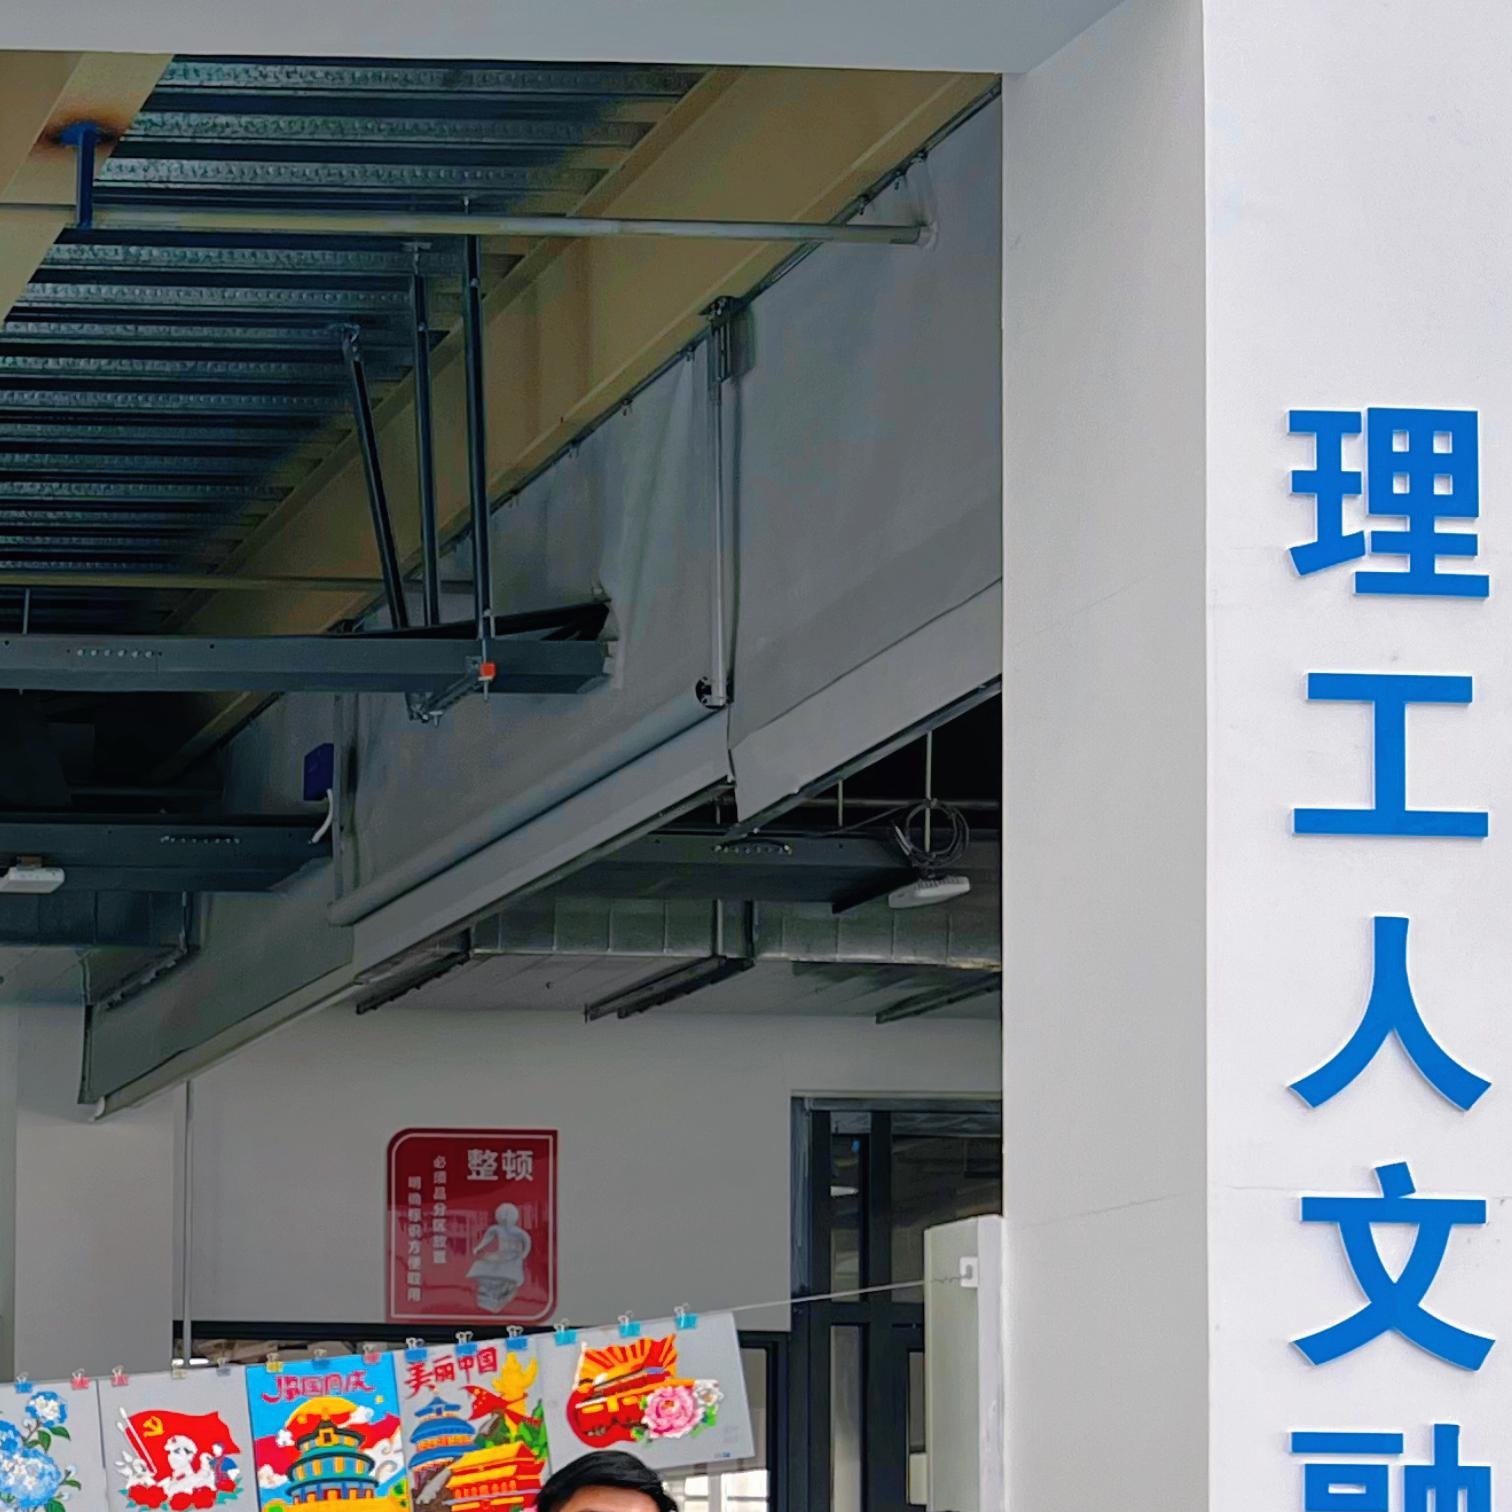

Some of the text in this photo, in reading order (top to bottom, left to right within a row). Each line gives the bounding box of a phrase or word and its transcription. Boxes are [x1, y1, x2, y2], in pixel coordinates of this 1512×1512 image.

[467, 1149, 534, 1182] 整顿
[404, 1346, 498, 1400] 美丽中国
